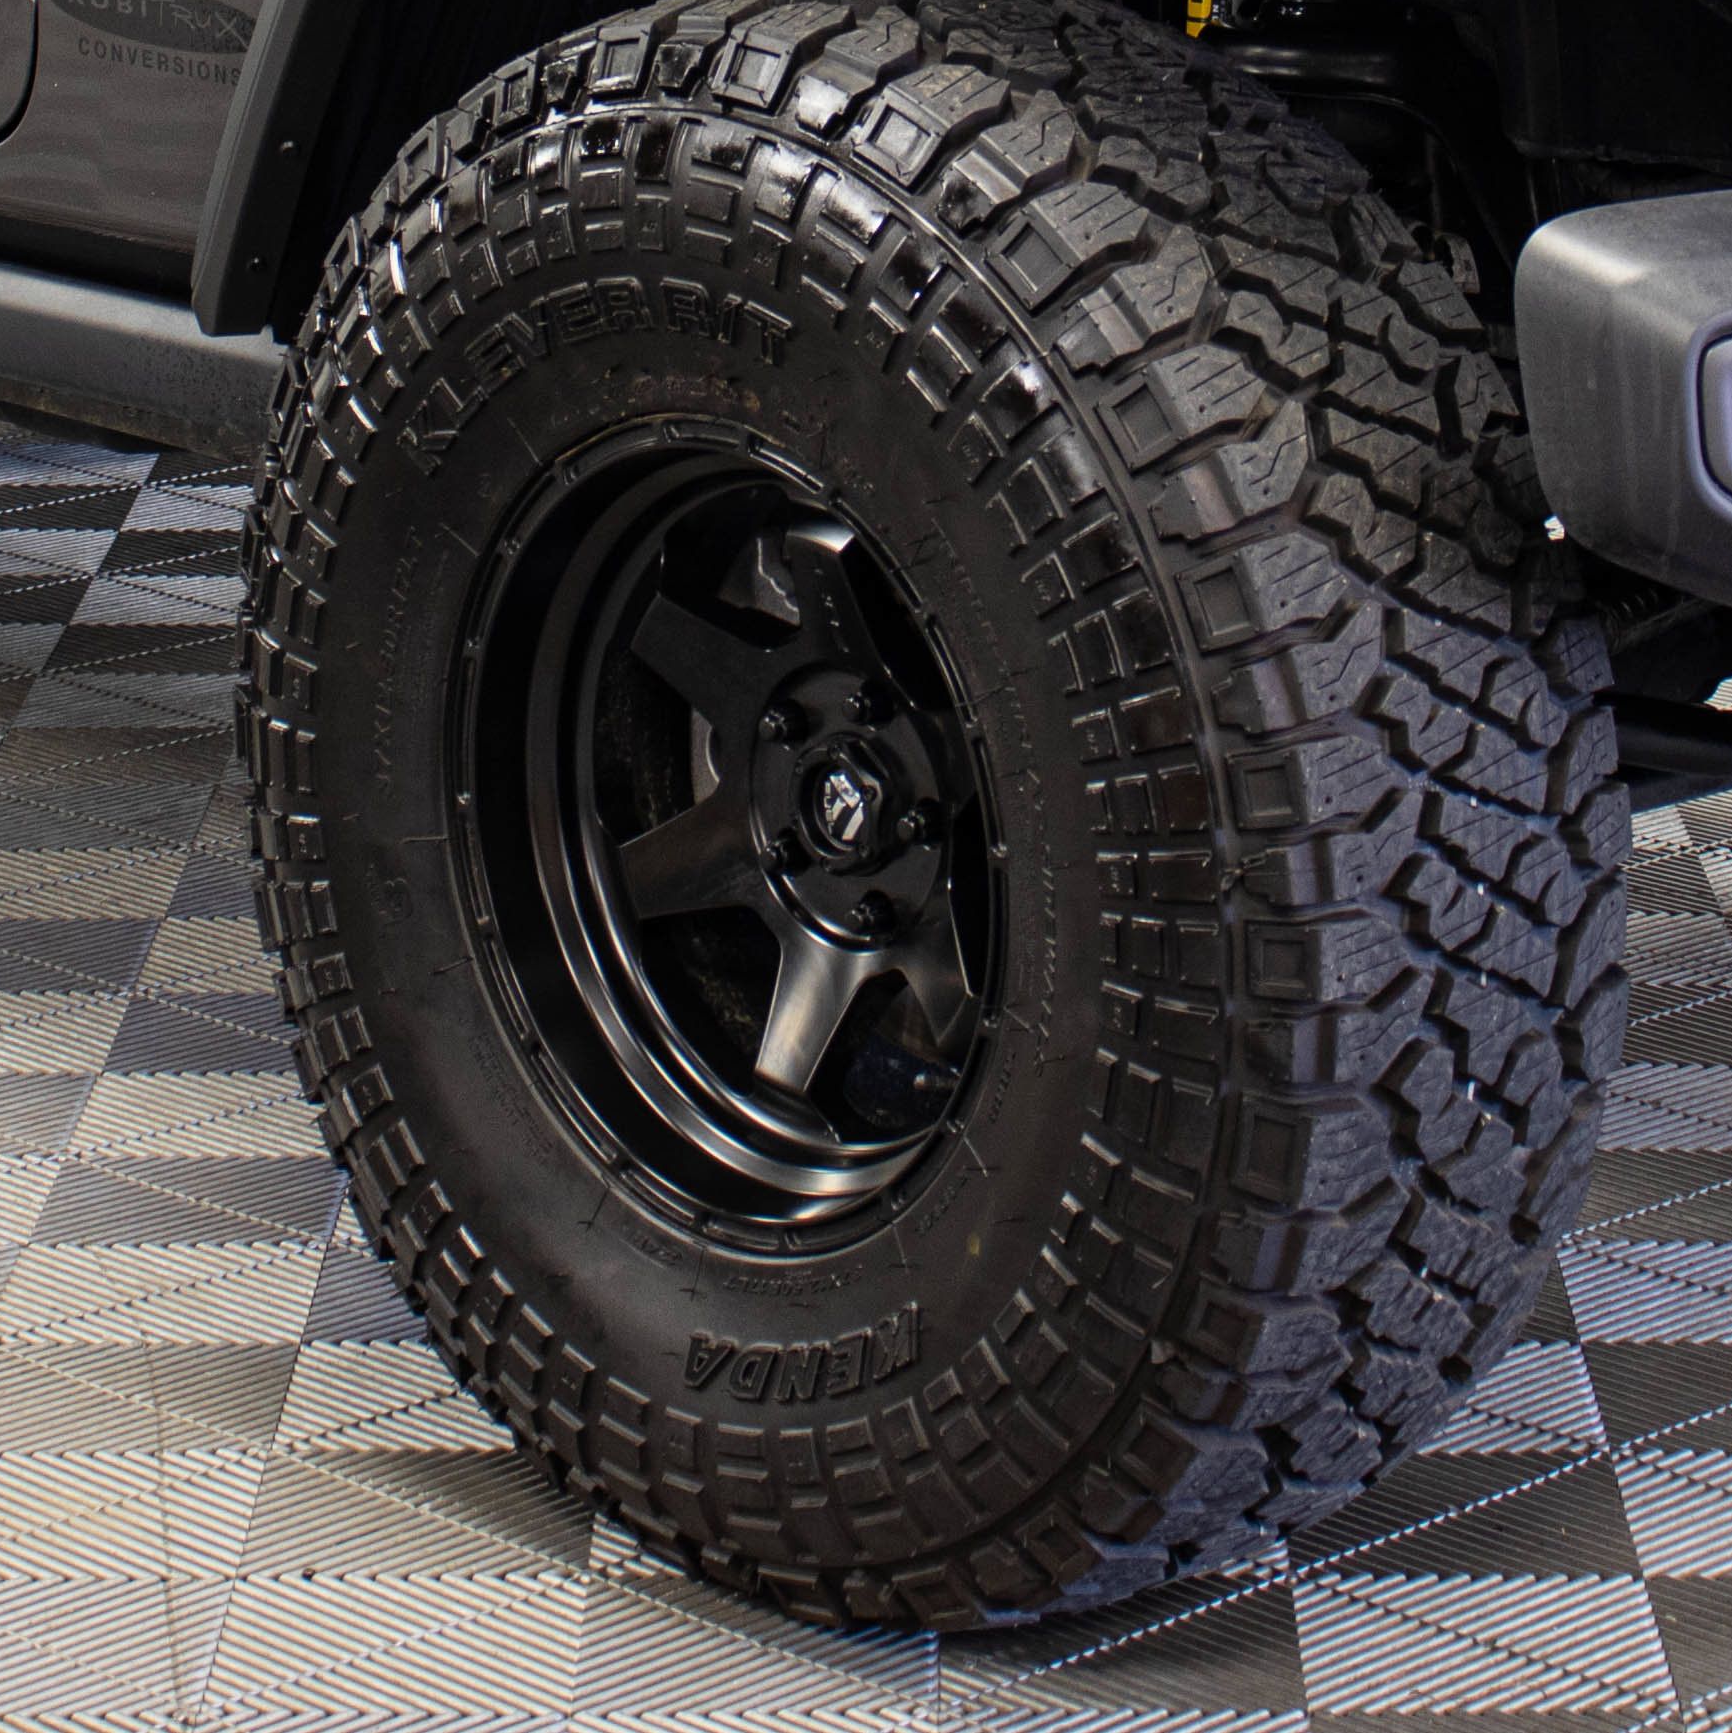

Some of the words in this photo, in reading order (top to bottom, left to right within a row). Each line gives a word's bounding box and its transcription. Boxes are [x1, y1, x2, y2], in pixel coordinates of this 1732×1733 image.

[78, 36, 245, 88] CONVERSIONS
[396, 275, 655, 476] KLEVER
[683, 1300, 921, 1404] KENDA
